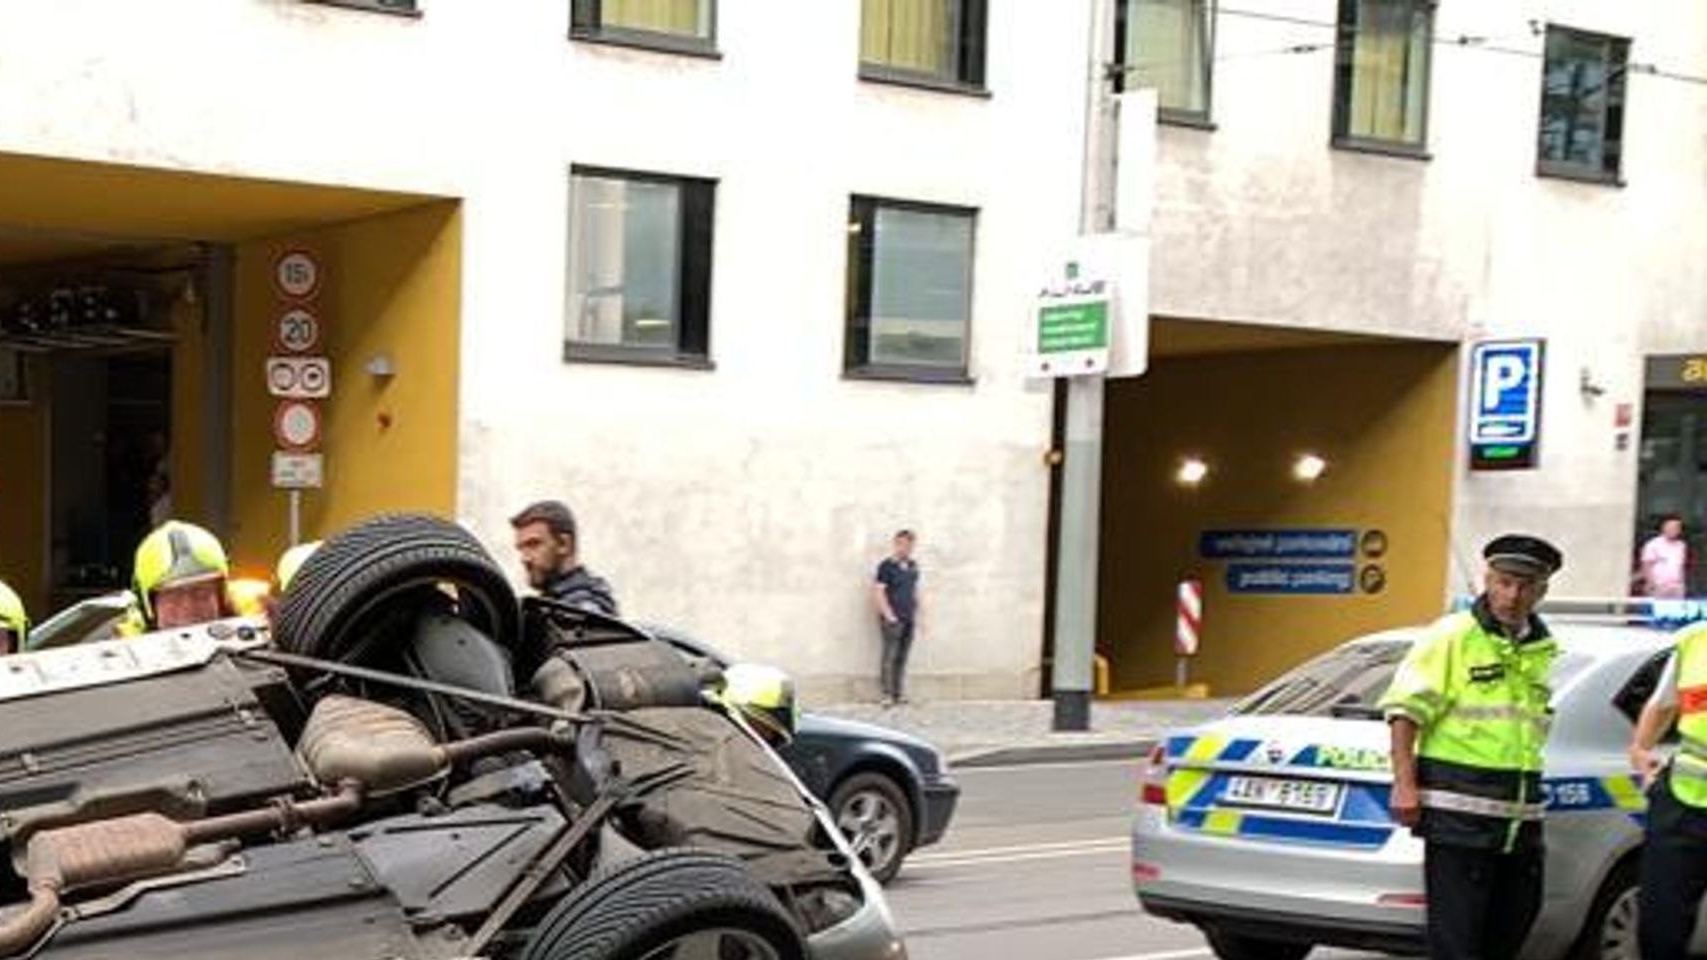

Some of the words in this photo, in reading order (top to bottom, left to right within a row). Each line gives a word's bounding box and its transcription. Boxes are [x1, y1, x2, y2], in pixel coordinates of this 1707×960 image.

[284, 318, 311, 343] 20
[1483, 353, 1526, 411] P
[1316, 745, 1391, 770] POLIC
